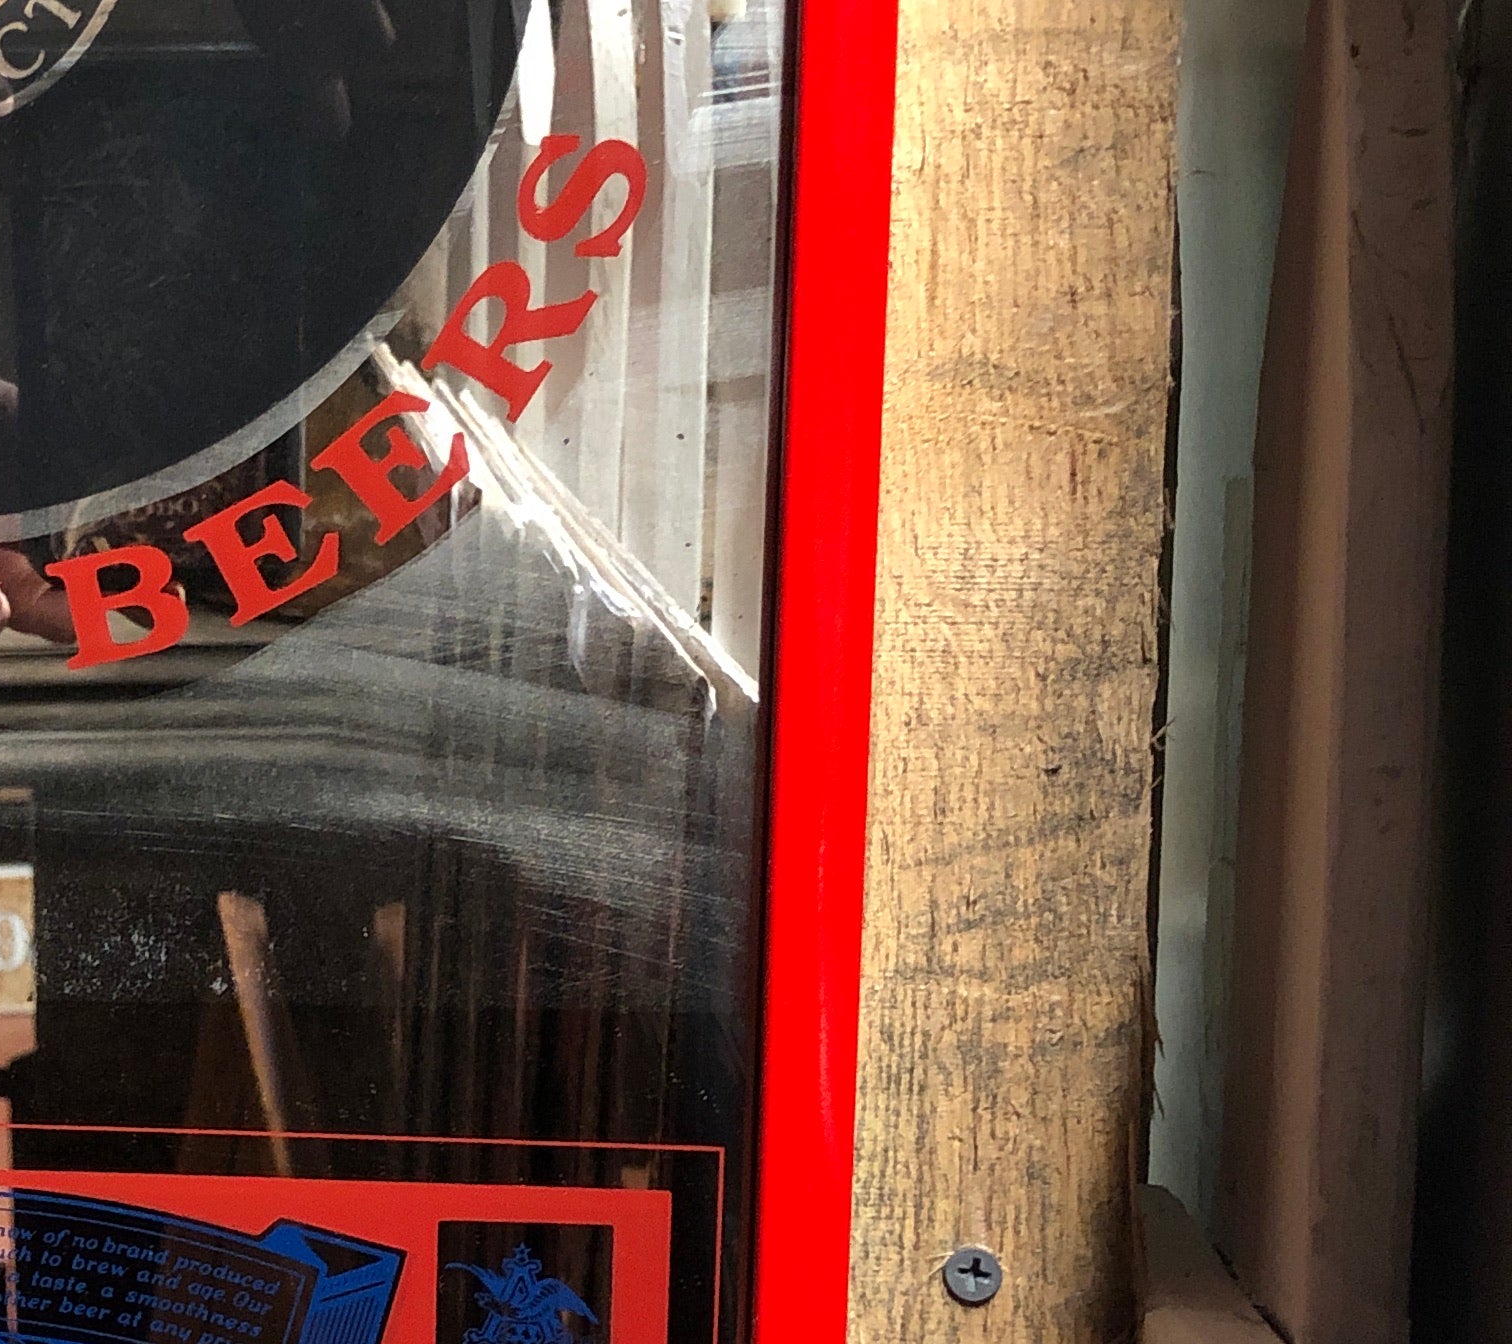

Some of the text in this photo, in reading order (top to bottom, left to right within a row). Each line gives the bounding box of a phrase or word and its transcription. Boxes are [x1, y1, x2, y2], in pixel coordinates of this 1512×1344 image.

[45, 134, 648, 672] BEERS
[40, 1247, 64, 1267] to
[72, 1254, 126, 1278] brew
[136, 1267, 179, 1291] and
[234, 1290, 274, 1316] Our
[43, 1227, 71, 1248] of
[72, 1235, 99, 1252] no
[103, 1238, 170, 1266] brand
[173, 1256, 281, 1297] produced
[58, 1296, 109, 1321] beer
[117, 1308, 143, 1328] at
[149, 1318, 190, 1343] any
[100, 1284, 115, 1298] a
[124, 1288, 264, 1337] smoothness
